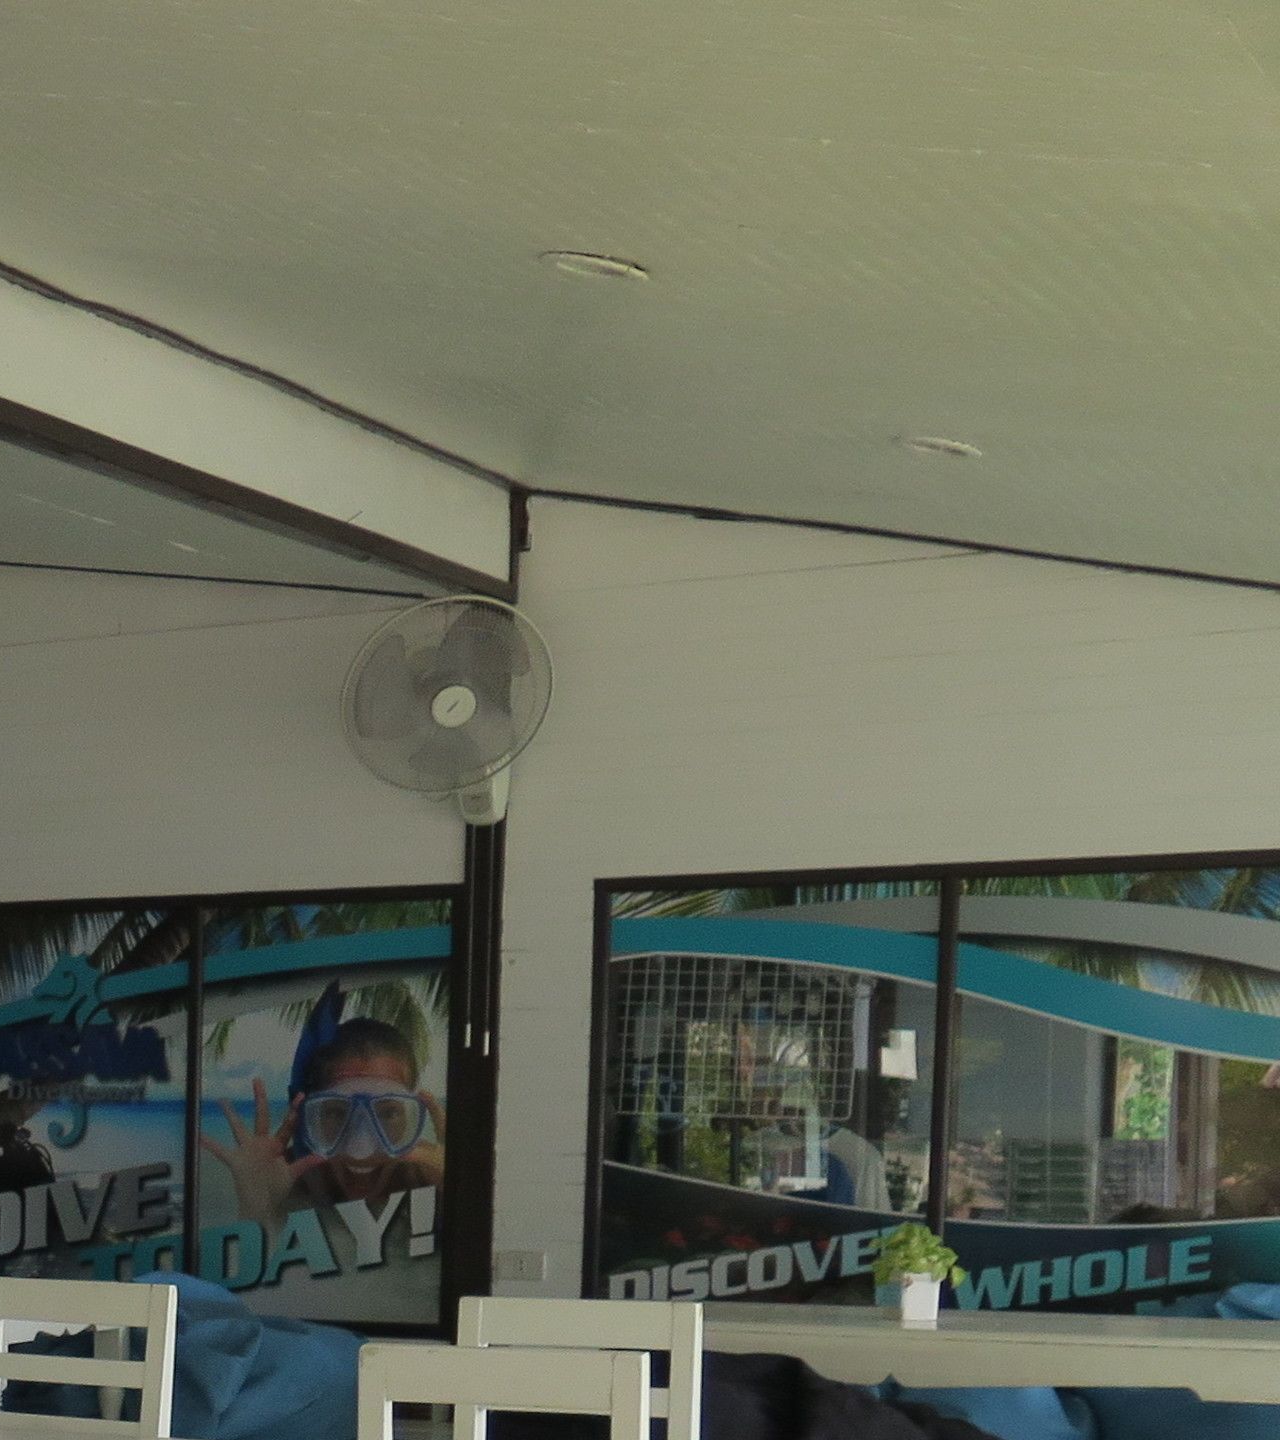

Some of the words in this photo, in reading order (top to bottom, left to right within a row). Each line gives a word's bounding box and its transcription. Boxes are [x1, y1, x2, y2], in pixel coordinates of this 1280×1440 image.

[78, 1185, 437, 1291] TODAY!
[608, 1226, 900, 1301] DISCOVE
[953, 1235, 1214, 1311] WHOLE
